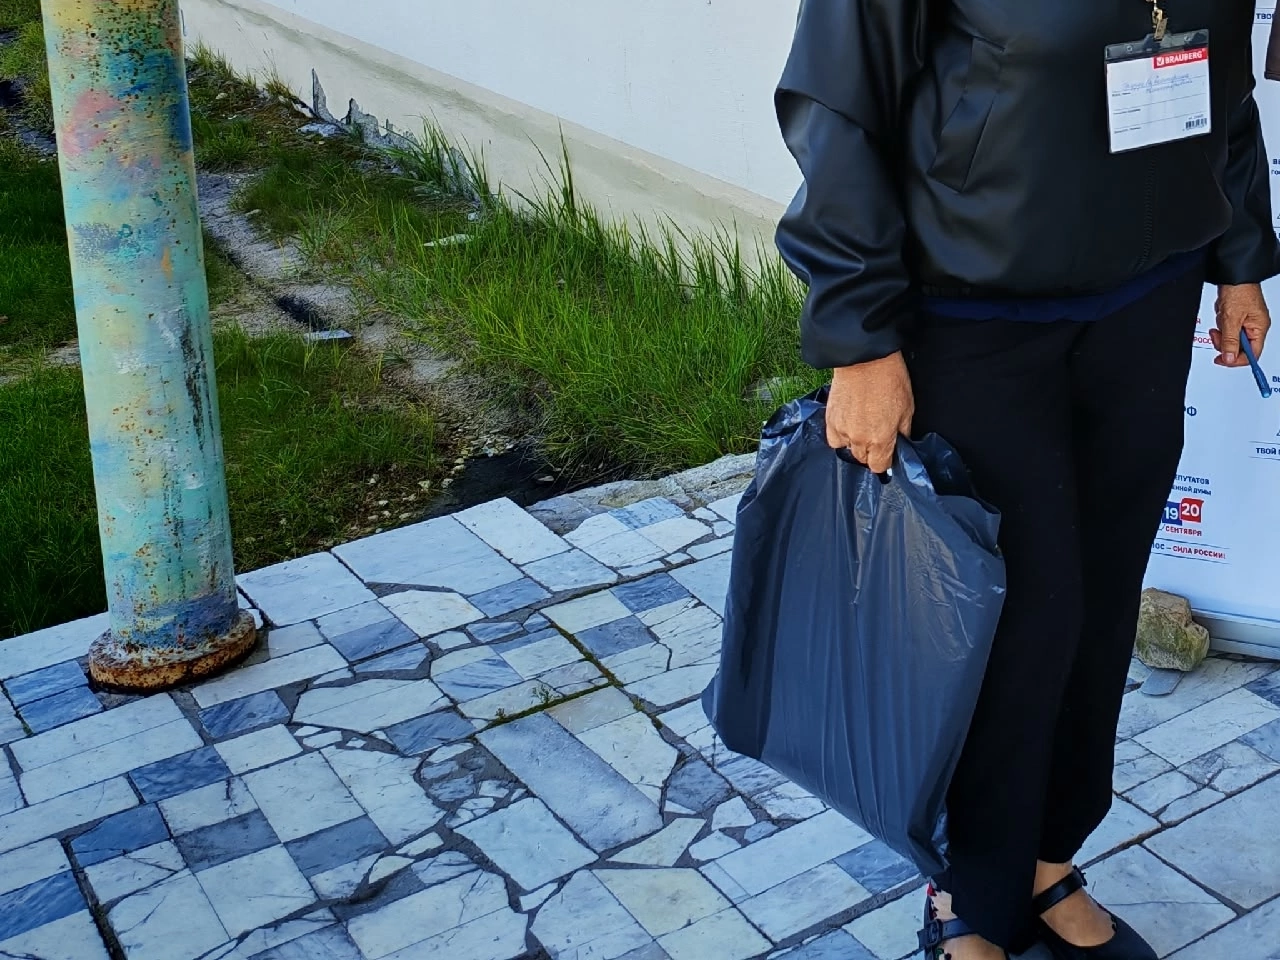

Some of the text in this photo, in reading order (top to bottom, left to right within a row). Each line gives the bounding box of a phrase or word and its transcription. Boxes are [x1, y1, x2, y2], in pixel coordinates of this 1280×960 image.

[1165, 51, 1203, 65] BRAUBERG
[1256, 446, 1276, 455] ТВОЙ
[1163, 503, 1200, 520] 19 20
[1165, 525, 1202, 537] СЕНТЯБРЯ
[1172, 545, 1192, 554] СИЛА
